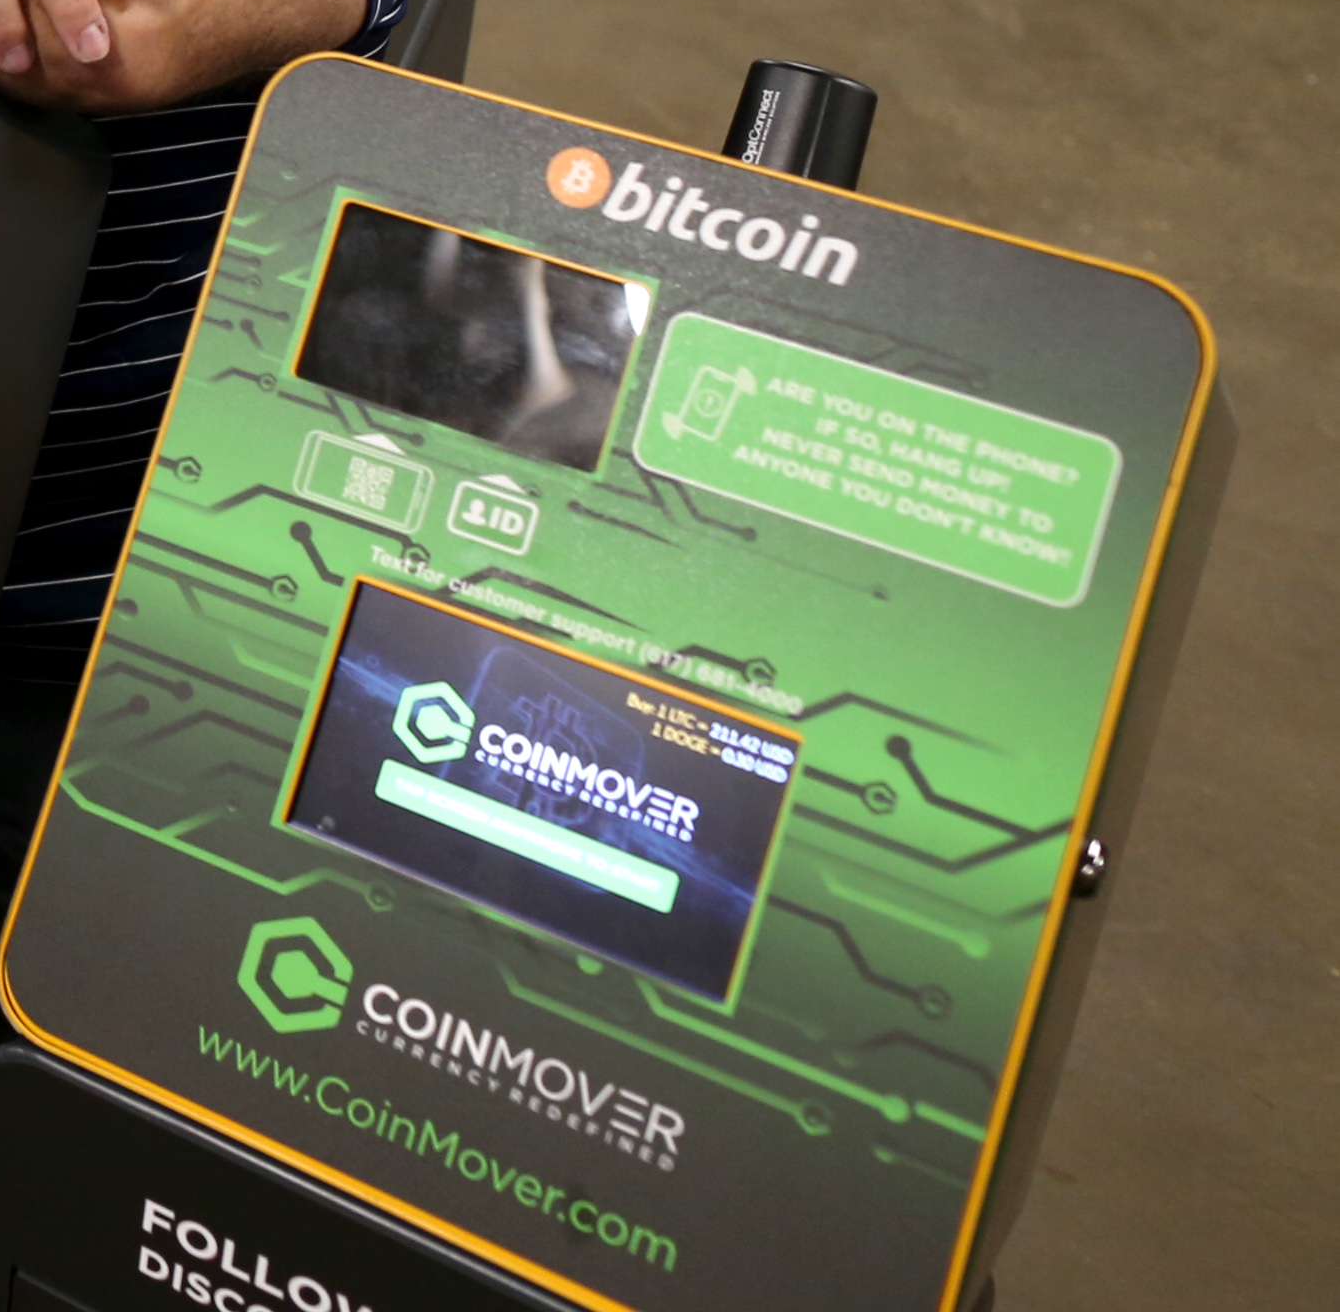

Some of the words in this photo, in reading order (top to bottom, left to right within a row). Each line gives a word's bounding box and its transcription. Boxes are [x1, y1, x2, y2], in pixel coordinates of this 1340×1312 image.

[741, 89, 773, 164] OptConnect
[601, 161, 858, 286] bitcoin
[762, 426, 843, 465] NEVER
[848, 453, 914, 488] SEND
[919, 476, 1010, 519] MONEY
[1018, 507, 1052, 533] TO
[766, 376, 816, 404] ARE
[823, 392, 873, 421] YOU
[877, 411, 916, 436] ON
[923, 423, 970, 453] THE
[974, 441, 1078, 486] PHONE?
[815, 417, 841, 435] IF
[844, 425, 882, 455] SO,
[889, 441, 961, 477] HANG
[967, 465, 1010, 492] UP!
[489, 507, 524, 536] ID
[733, 443, 832, 489] ANYONE
[840, 477, 891, 507] YOU
[895, 496, 974, 534] DON'T
[979, 524, 1070, 563] KNOW!
[371, 546, 412, 576] Text
[416, 562, 446, 587] for
[449, 578, 549, 622] customer
[551, 612, 638, 655] support
[474, 749, 576, 796] CURRENCY
[578, 789, 693, 842] REDEFINED
[477, 724, 699, 831] COINMOVER
[356, 1021, 499, 1093] CURRENCY
[510, 1088, 673, 1170] REDEFINED
[362, 984, 683, 1153] COINMOVER
[199, 1025, 675, 1269] www.CoinMover.com
